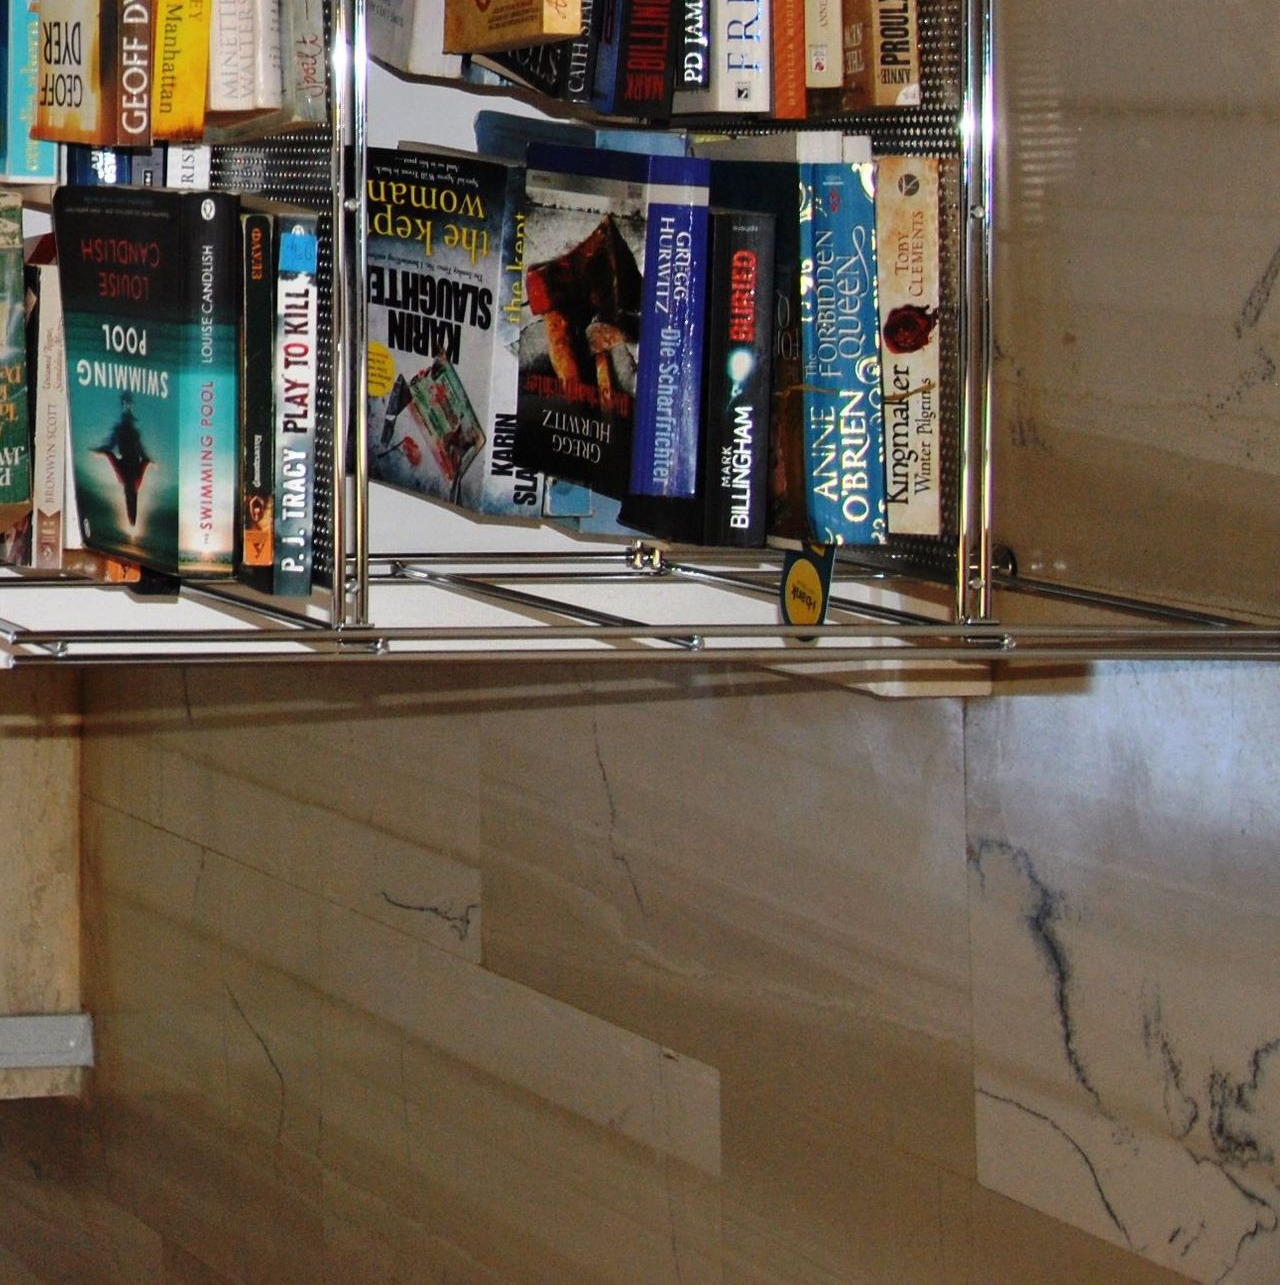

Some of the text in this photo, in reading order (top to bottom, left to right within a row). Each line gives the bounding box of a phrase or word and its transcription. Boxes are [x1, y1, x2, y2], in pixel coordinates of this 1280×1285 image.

[818, 0, 829, 28] ANNE
[41, 21, 82, 66] DYER
[160, 3, 186, 114] Manhattan
[684, 51, 703, 83] PD
[40, 72, 83, 108] GEOFF
[122, 37, 150, 136] GEOFF
[567, 42, 590, 94] CATH
[624, 73, 665, 100] MARK
[879, 68, 911, 85] ANNIE
[366, 179, 487, 219] woman
[80, 239, 161, 269] CANDLISH
[366, 204, 434, 257] kep
[443, 223, 491, 268] the
[908, 210, 925, 298] CLEMENTS
[98, 272, 150, 301] LOUISE
[199, 245, 215, 315] CANDLISH
[654, 215, 676, 314] HURWITZ
[283, 288, 310, 337] KILL
[366, 262, 493, 330] SLAUGHTE
[503, 281, 523, 324] the
[728, 250, 757, 343] BURIED
[101, 323, 148, 357] POOL
[200, 318, 214, 365] LOUISE
[282, 342, 310, 370] TO
[387, 309, 462, 366] KARIN
[652, 230, 693, 485] GREGG Die Scharfrichter
[77, 359, 170, 400] SWIMMING
[803, 353, 817, 380] The
[45, 403, 58, 441] SCOTT
[199, 381, 215, 428] POOL
[282, 377, 310, 435] PLAY
[541, 409, 611, 444] HURWITZ
[490, 413, 517, 477] KARIN
[552, 434, 601, 464] GREGG
[809, 405, 839, 503] ANNE
[838, 389, 870, 524] O'BRIEN
[884, 364, 918, 506] Kingmaker
[43, 442, 57, 505] BRONWYN
[199, 435, 215, 531] SWIMMING
[282, 448, 307, 522] TRACY
[720, 445, 732, 488] MARK
[729, 406, 754, 530] BILLINGHAM
[914, 441, 932, 495] Winter
[281, 530, 305, 548] J.
[281, 554, 305, 574] P.
